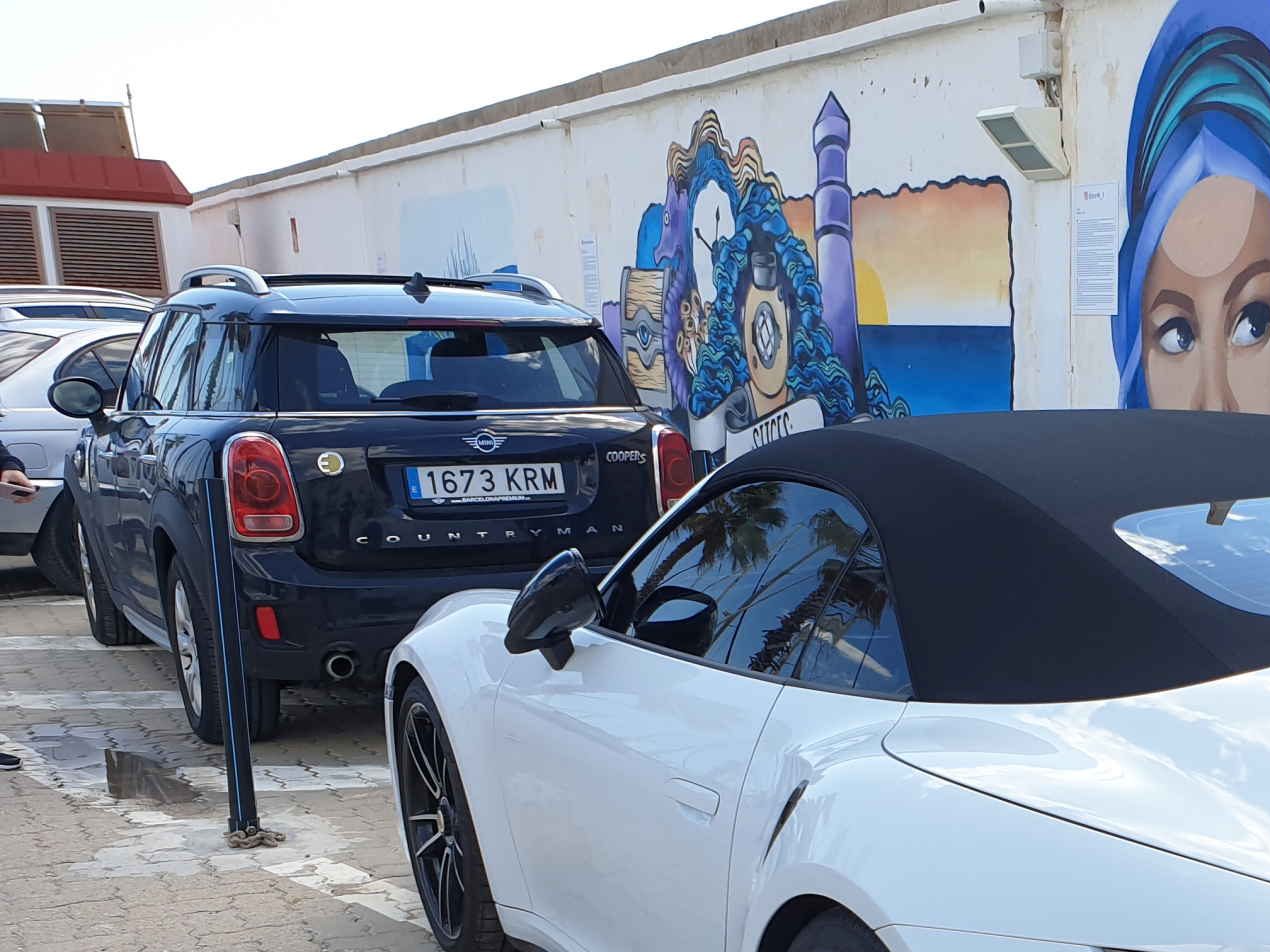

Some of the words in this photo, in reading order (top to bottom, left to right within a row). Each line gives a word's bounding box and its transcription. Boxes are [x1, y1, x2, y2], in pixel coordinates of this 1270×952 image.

[411, 486, 418, 494] E
[427, 469, 496, 495] 1673
[505, 466, 558, 491] KRM
[356, 524, 623, 544] COUNTRYMAN
